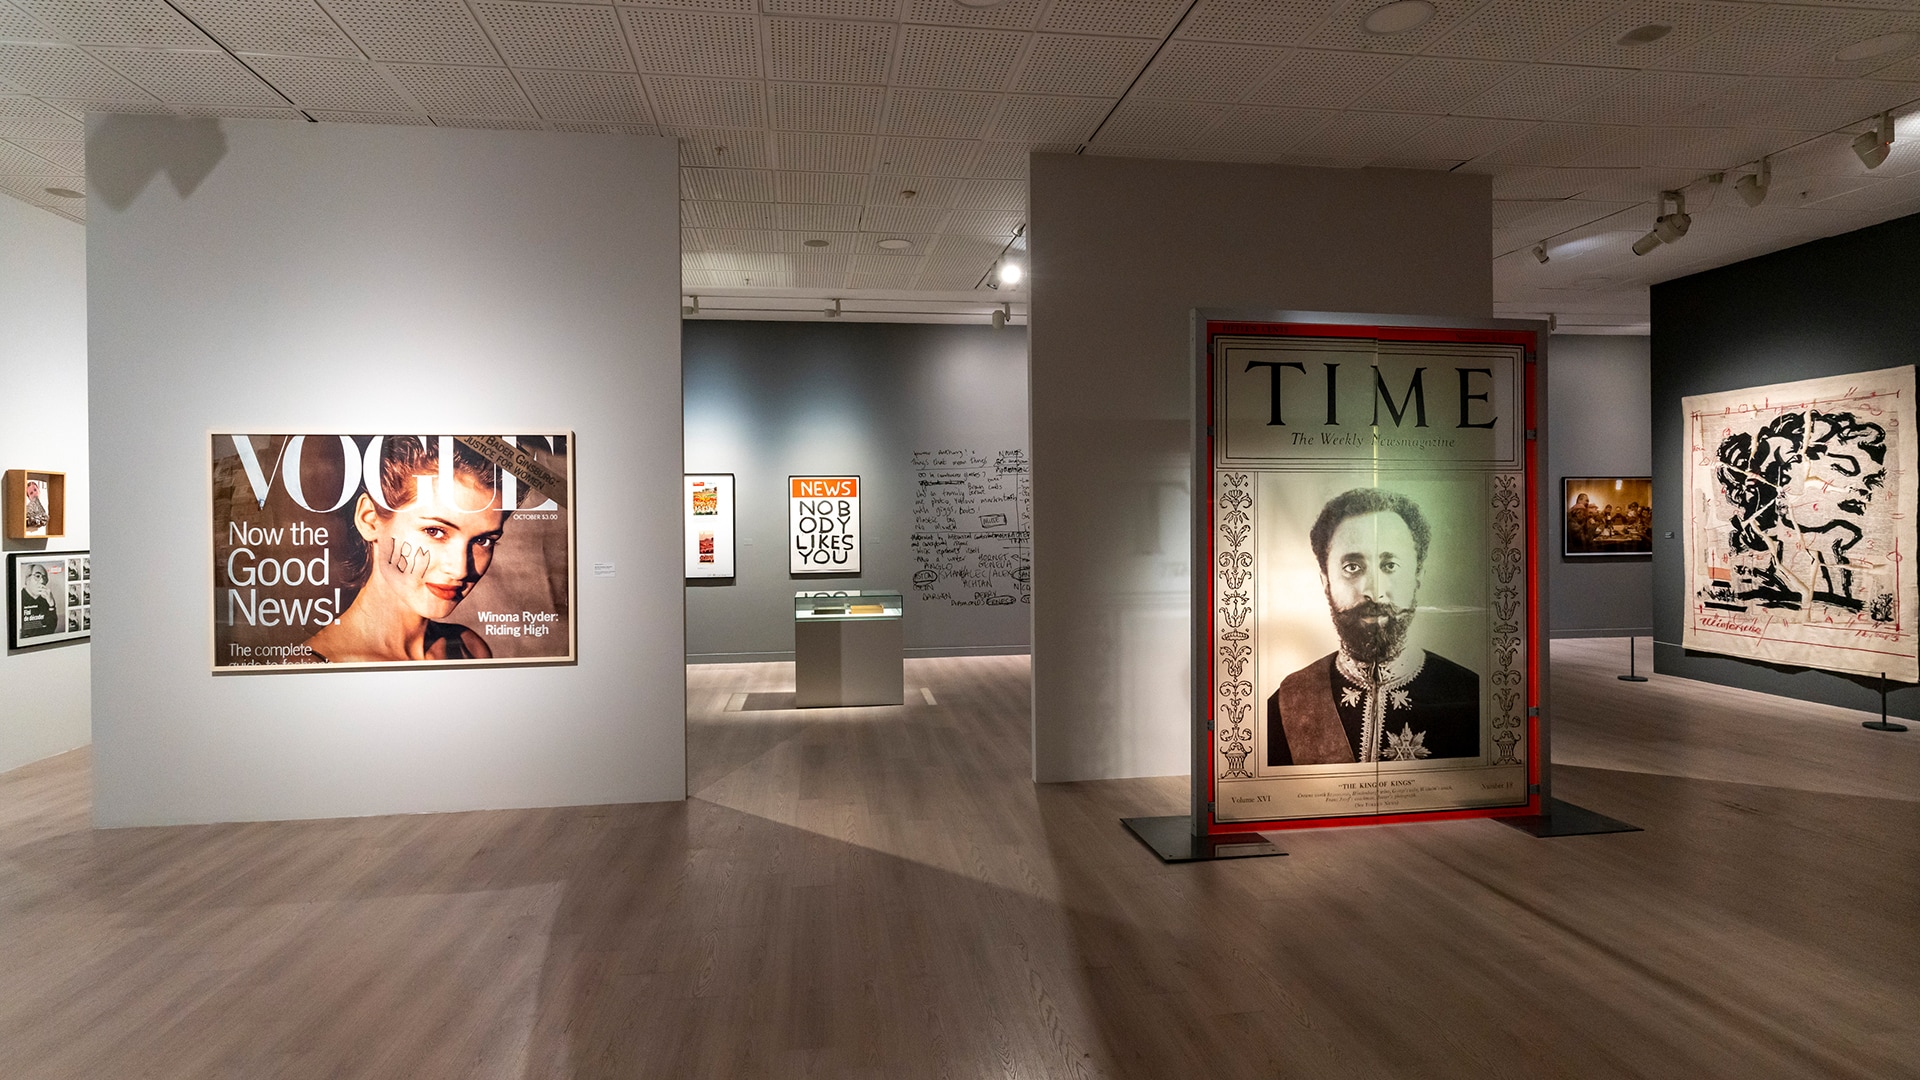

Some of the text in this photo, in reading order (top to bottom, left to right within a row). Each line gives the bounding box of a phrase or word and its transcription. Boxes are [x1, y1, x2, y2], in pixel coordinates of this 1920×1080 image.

[1244, 360, 1498, 429] TIME
[486, 435, 515, 459] BADER
[1291, 432, 1455, 450] The Weekly Newsmagazine
[464, 436, 545, 490] JUSTICE FOR WOMEN
[231, 435, 557, 513] VOGUE
[800, 481, 852, 497] NEWS
[799, 500, 851, 516] NOB
[229, 522, 329, 546] Now the
[799, 516, 851, 535] ODY
[796, 534, 854, 550] LIKES
[390, 537, 431, 578] IBM
[798, 549, 848, 565] YOU
[228, 548, 329, 587] Good
[228, 588, 341, 627] News!
[478, 611, 559, 625] Winona Ryder:
[485, 623, 549, 638] Riding High
[228, 642, 312, 658] The complete
